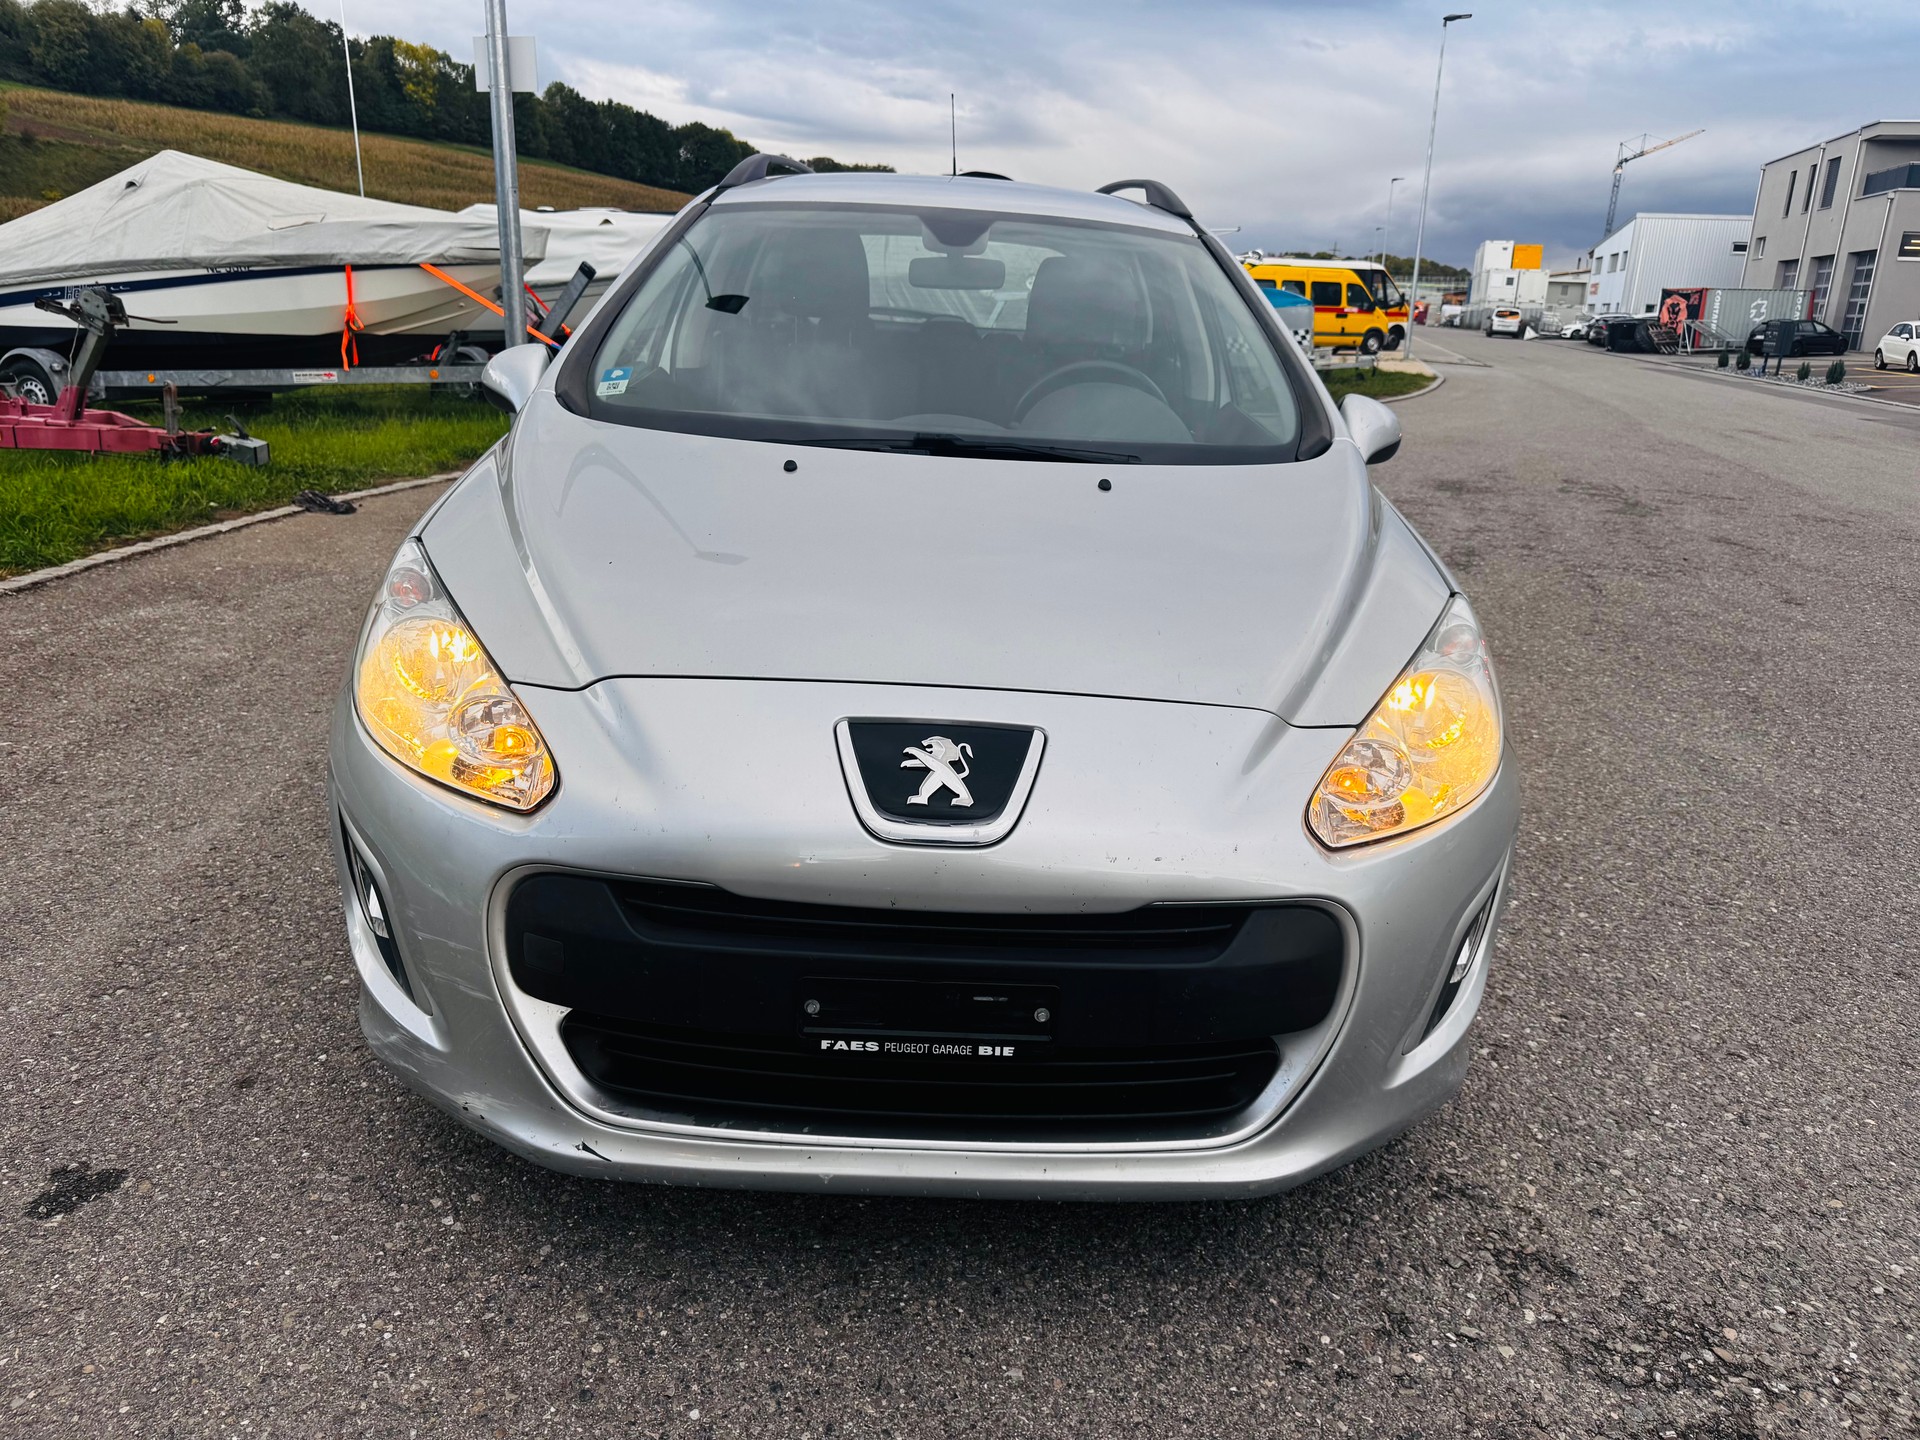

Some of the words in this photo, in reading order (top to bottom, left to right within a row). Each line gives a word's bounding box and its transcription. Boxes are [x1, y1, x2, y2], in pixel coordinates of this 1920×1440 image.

[820, 1039, 879, 1052] FAES
[884, 1042, 930, 1054] PEUGEOT
[932, 1044, 973, 1055] GARAGE
[978, 1045, 1015, 1057] BIE
